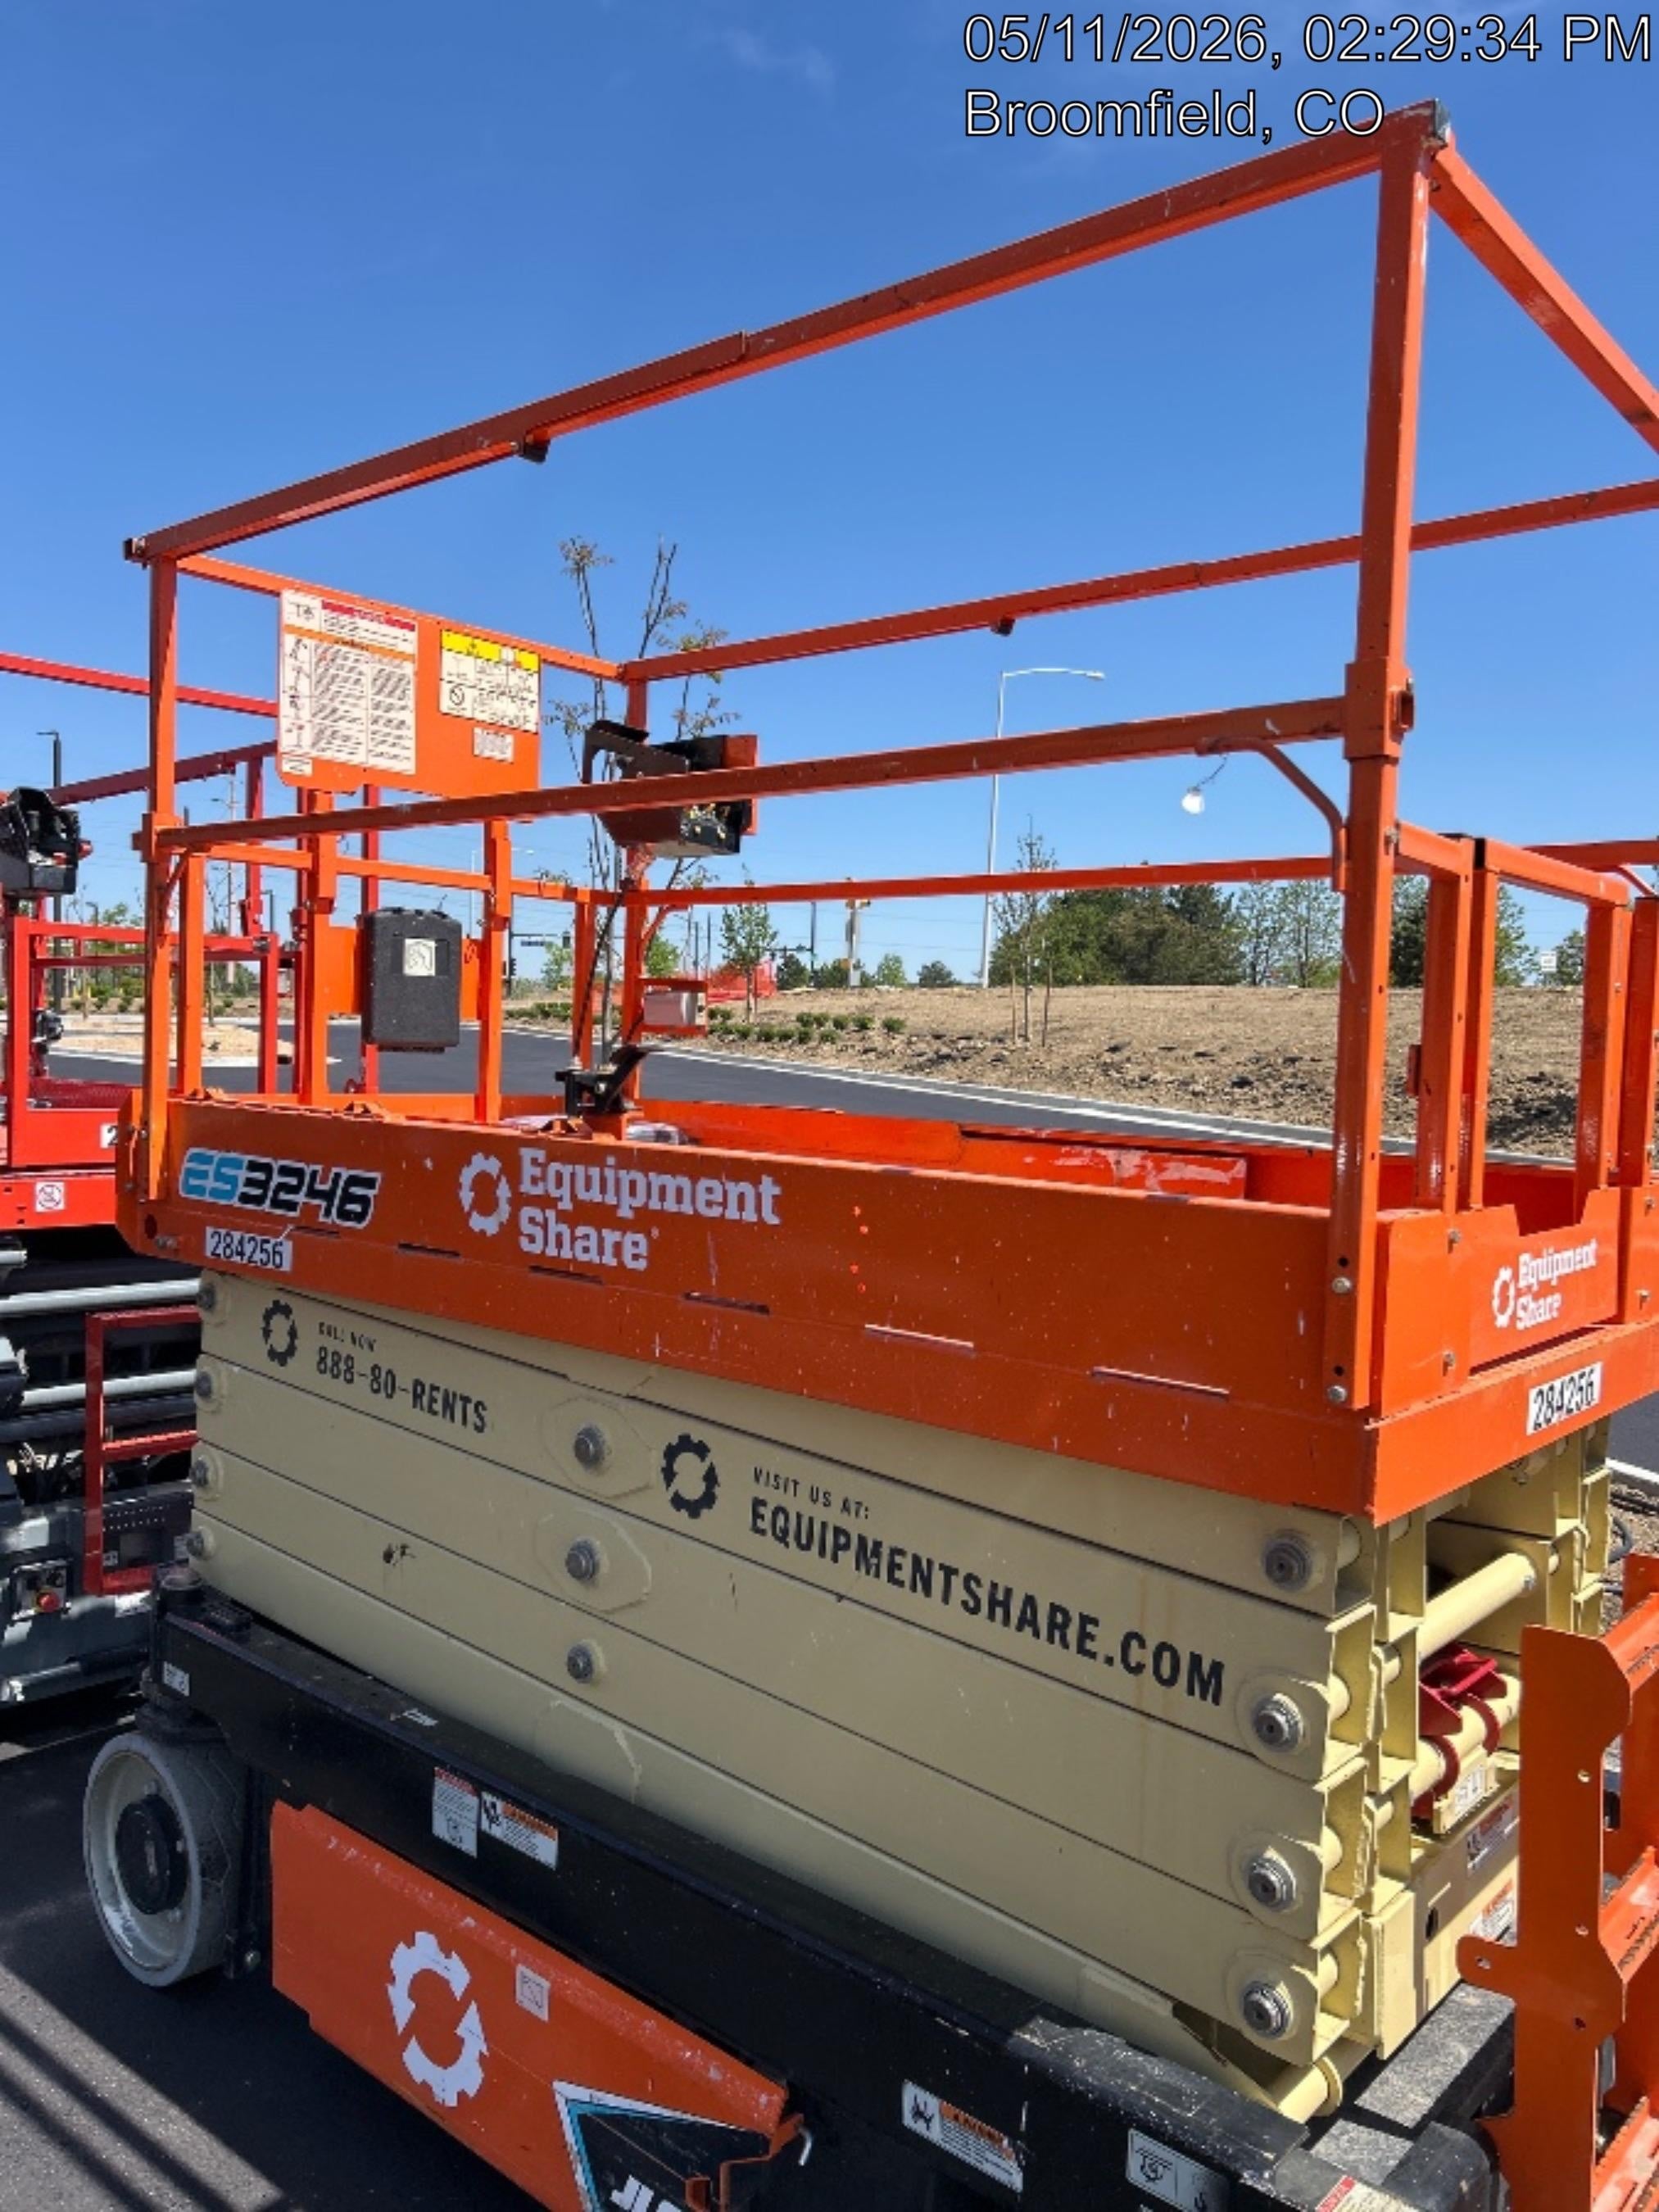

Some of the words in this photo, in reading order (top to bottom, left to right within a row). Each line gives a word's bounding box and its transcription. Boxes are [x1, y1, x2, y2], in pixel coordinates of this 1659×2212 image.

[179, 1148, 382, 1228] ES3246
[519, 1146, 782, 1226] Equipment
[210, 1230, 284, 1269] 284256
[1517, 1238, 1598, 1290] Equipment
[1516, 1292, 1562, 1330] Share
[316, 1344, 487, 1435] 888-80-RENTS
[1532, 1368, 1596, 1432] 284256
[754, 1466, 800, 1498] VISIT
[810, 1484, 832, 1507] US
[841, 1496, 869, 1520] AT:
[749, 1496, 1226, 1707] EQUIPMENTSHARE.COM
